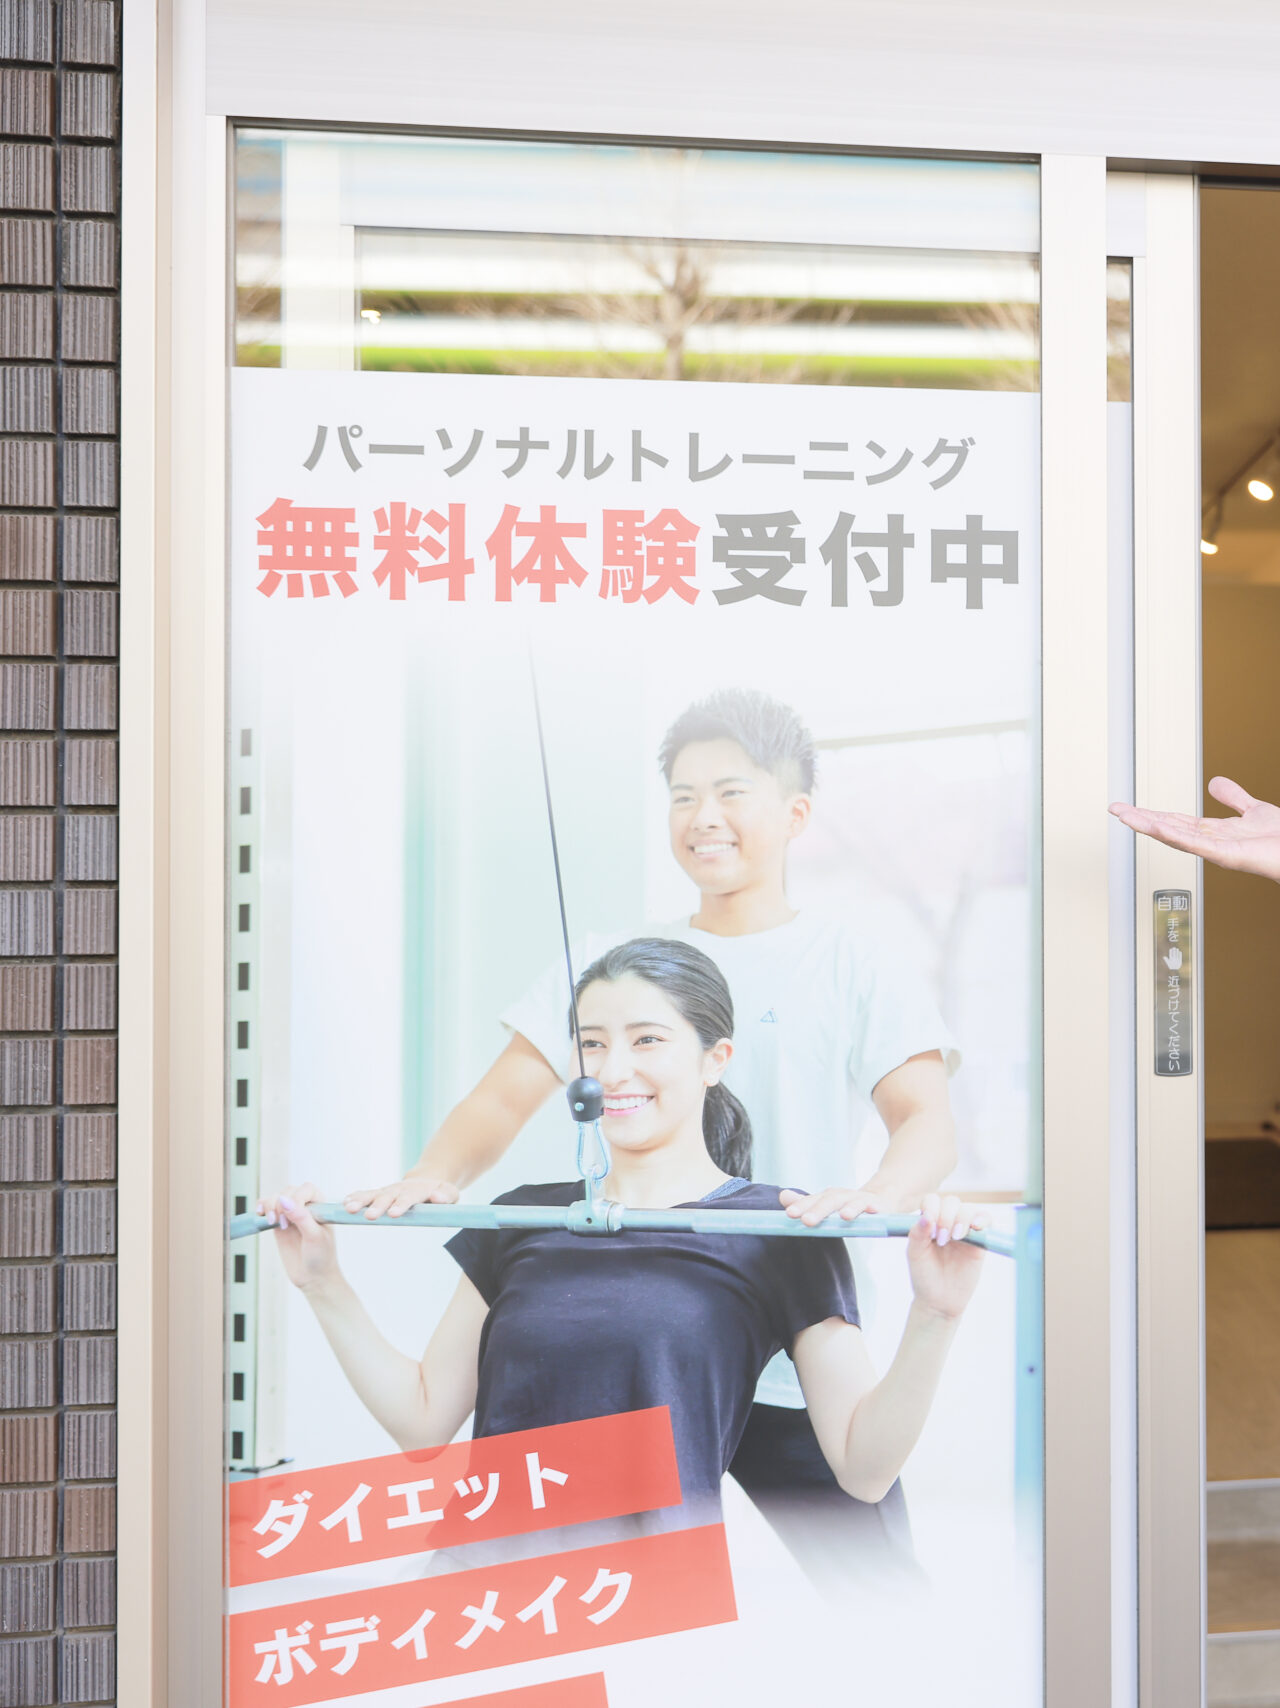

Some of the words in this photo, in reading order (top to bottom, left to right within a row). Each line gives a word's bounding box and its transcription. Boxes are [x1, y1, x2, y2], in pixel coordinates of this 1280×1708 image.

[302, 424, 976, 491] パーソナルトレーニング
[255, 497, 1020, 610] 無料体験受付中
[1157, 895, 1188, 912] 自動
[253, 1451, 569, 1559] ダイエット
[253, 1567, 633, 1686] ボディメイク
